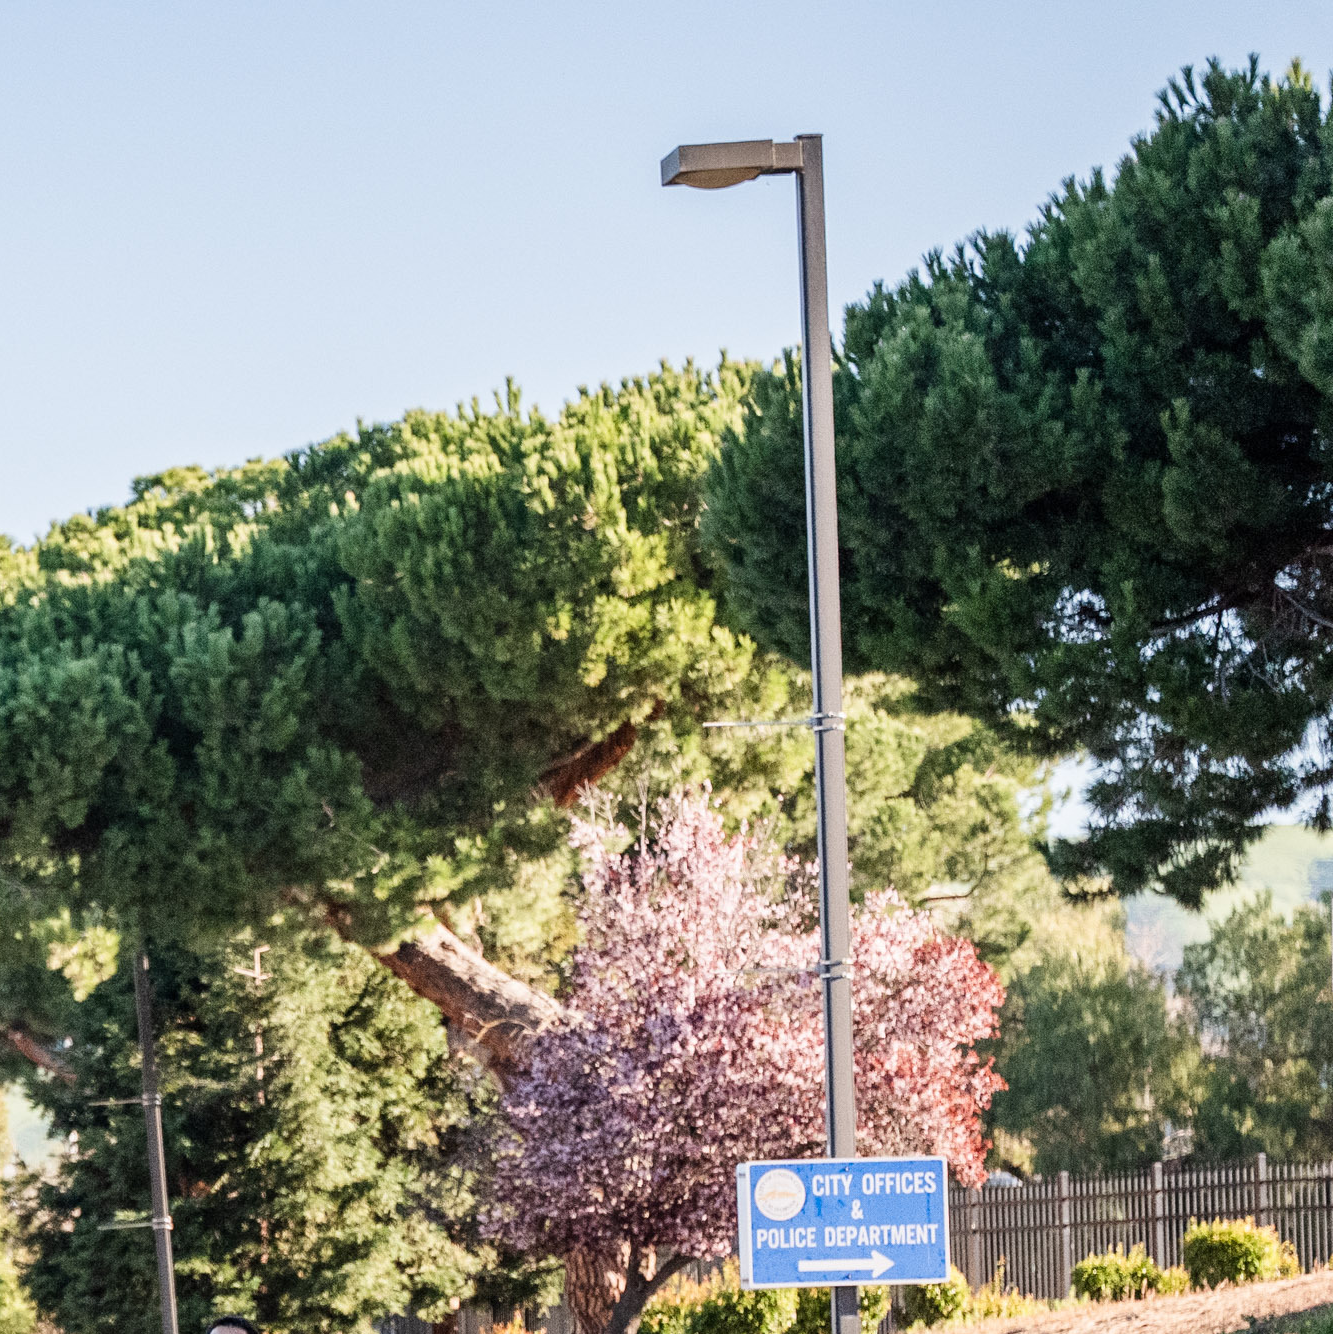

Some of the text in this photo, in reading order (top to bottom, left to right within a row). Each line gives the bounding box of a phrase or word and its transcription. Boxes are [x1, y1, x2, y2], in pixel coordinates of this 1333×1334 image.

[811, 1173, 853, 1197] CITY
[861, 1171, 937, 1195] OFFICES
[850, 1199, 864, 1220] &
[756, 1223, 939, 1250] POLICE DEPARTMENT
